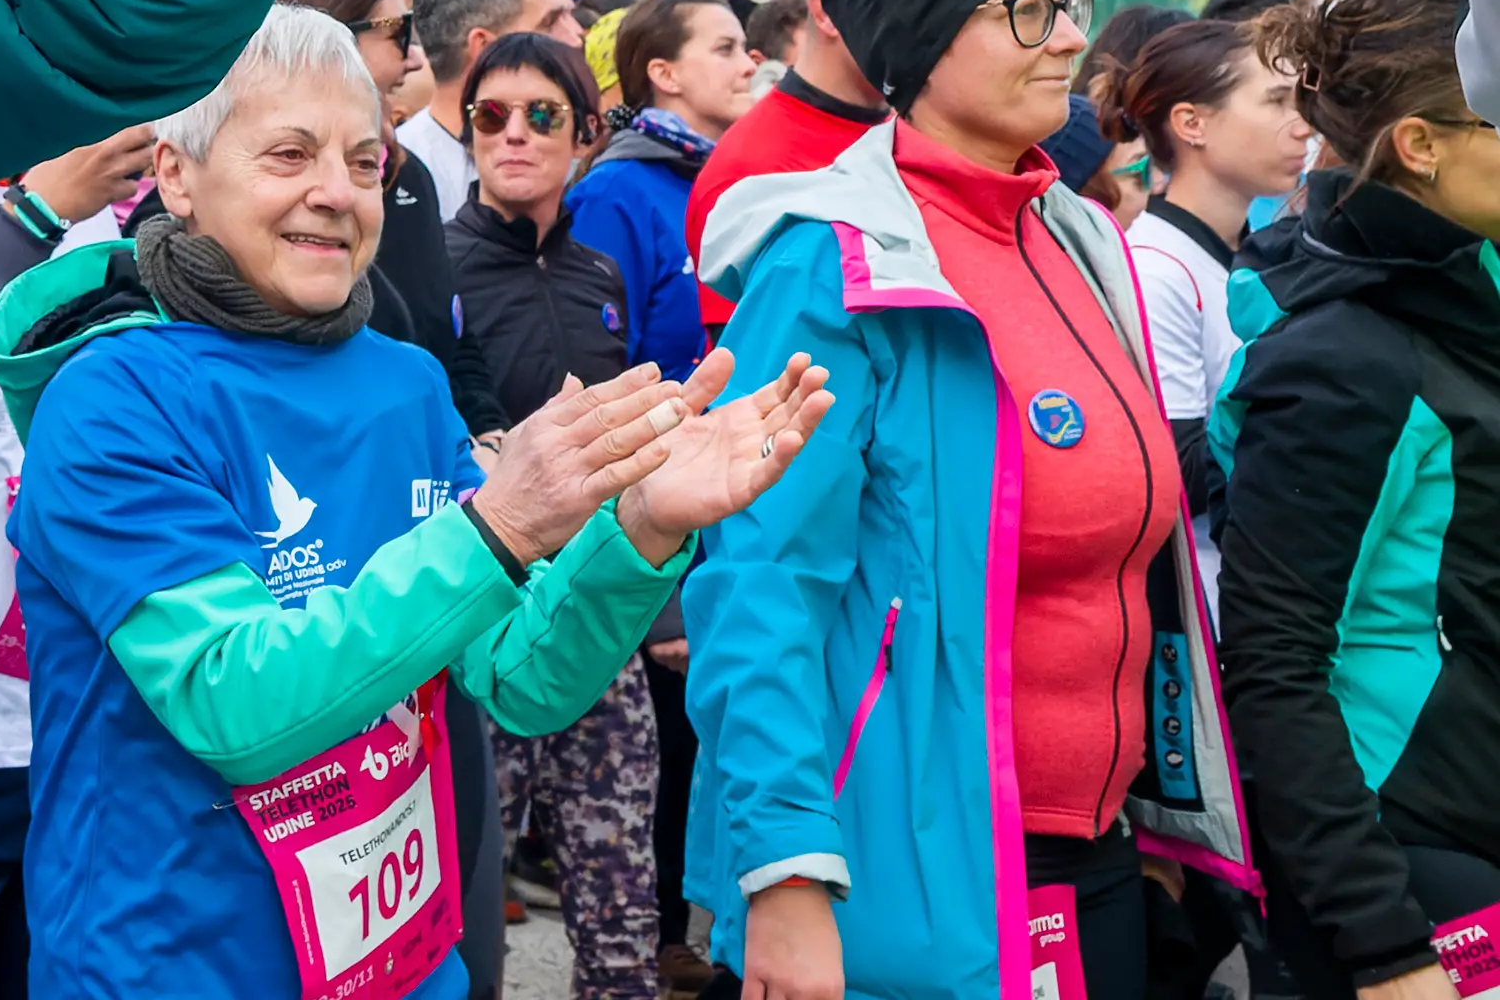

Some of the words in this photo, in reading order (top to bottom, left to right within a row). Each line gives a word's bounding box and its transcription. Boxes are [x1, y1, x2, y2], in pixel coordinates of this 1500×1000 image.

[294, 564, 326, 580] UDINE
[326, 558, 347, 572] odv
[249, 761, 347, 811] STAFFETTA
[255, 776, 351, 826] TELETHON
[262, 810, 316, 843] UDINE
[317, 794, 357, 822] 2025
[348, 828, 424, 941] 109
[1429, 924, 1489, 954] FETTA
[1443, 940, 1495, 967] THON
